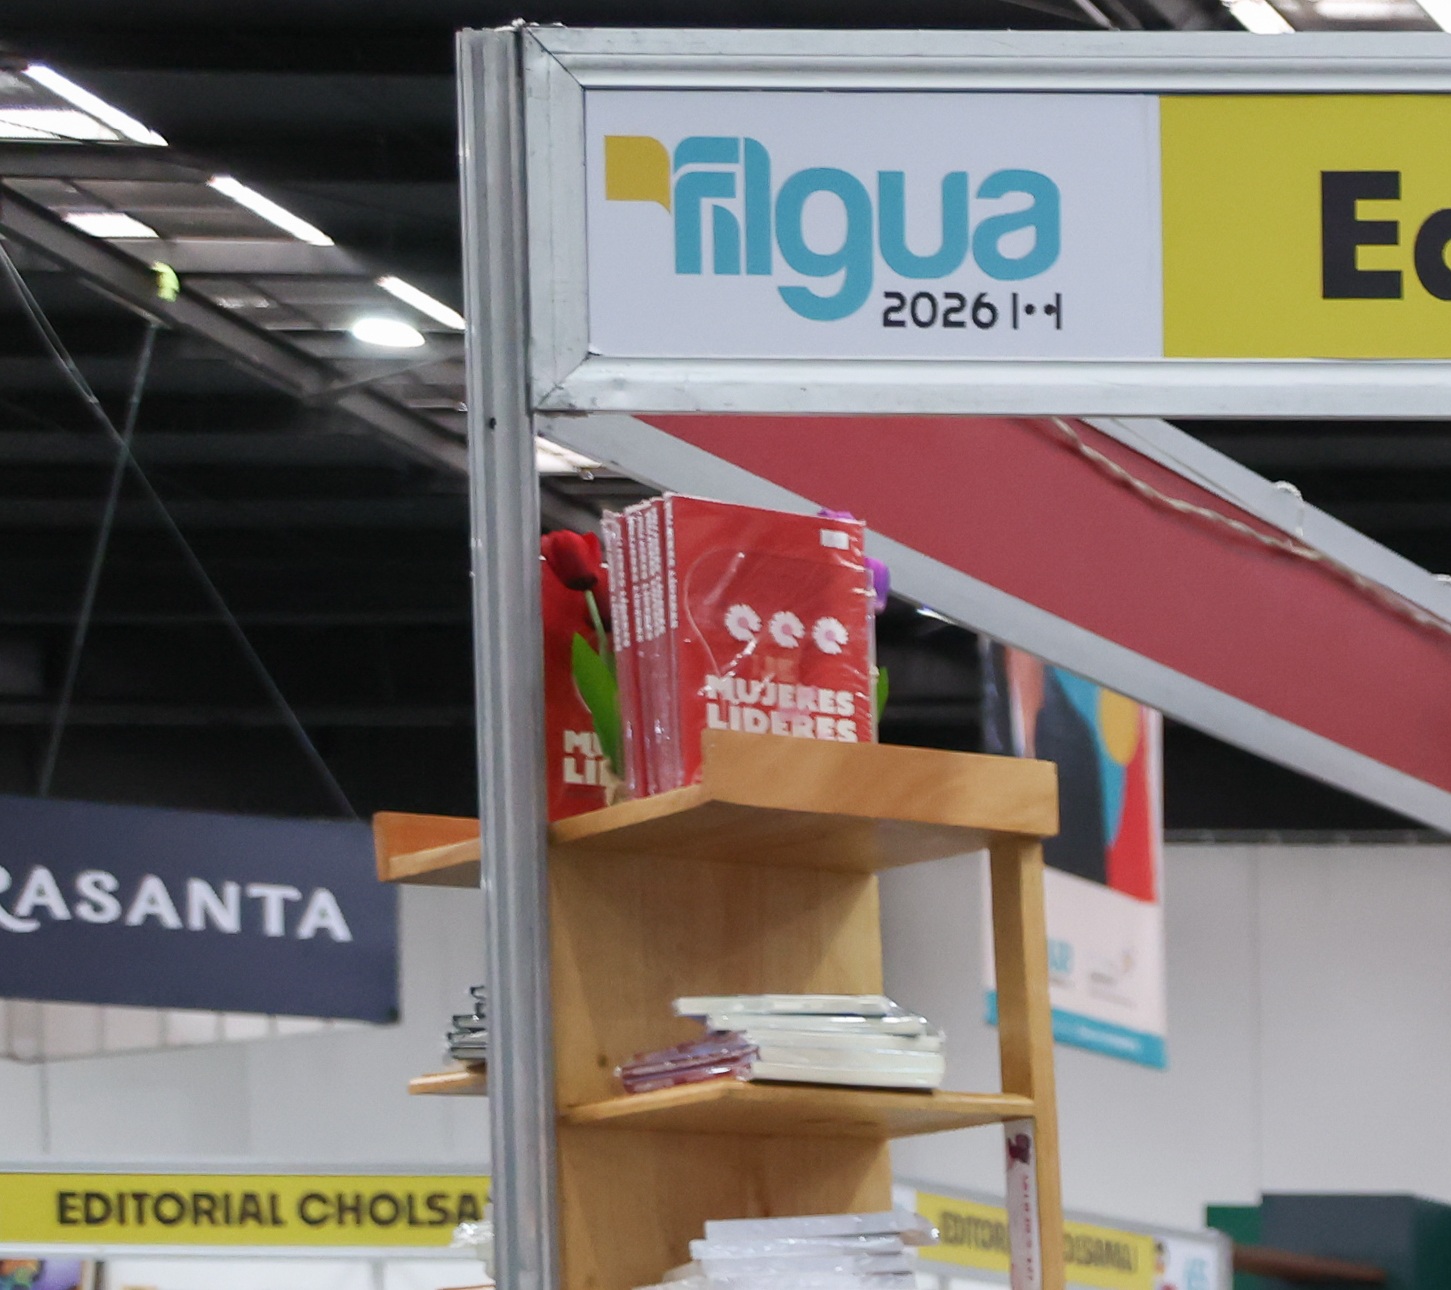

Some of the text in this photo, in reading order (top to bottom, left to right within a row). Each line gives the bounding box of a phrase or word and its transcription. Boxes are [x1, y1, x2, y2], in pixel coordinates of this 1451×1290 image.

[882, 290, 998, 330] 2026
[705, 674, 855, 716] MUJERES
[57, 1191, 495, 1226] EDITORIAL CHOLSA
